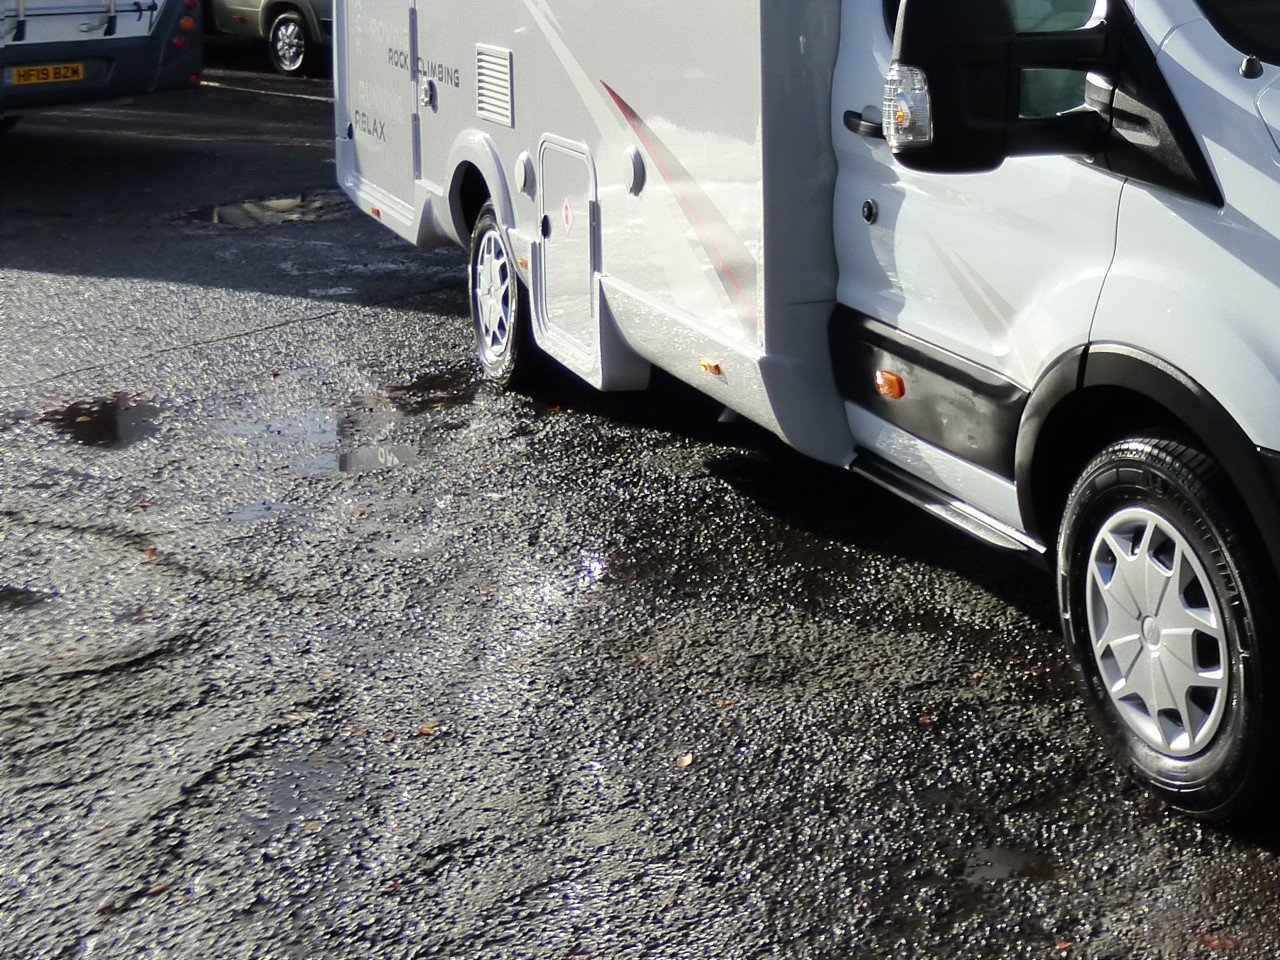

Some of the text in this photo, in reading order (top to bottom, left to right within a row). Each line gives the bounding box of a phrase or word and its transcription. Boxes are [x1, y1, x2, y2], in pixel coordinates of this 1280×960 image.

[388, 47, 460, 88] ROCK CLIMBING
[354, 109, 386, 142] RELAX
